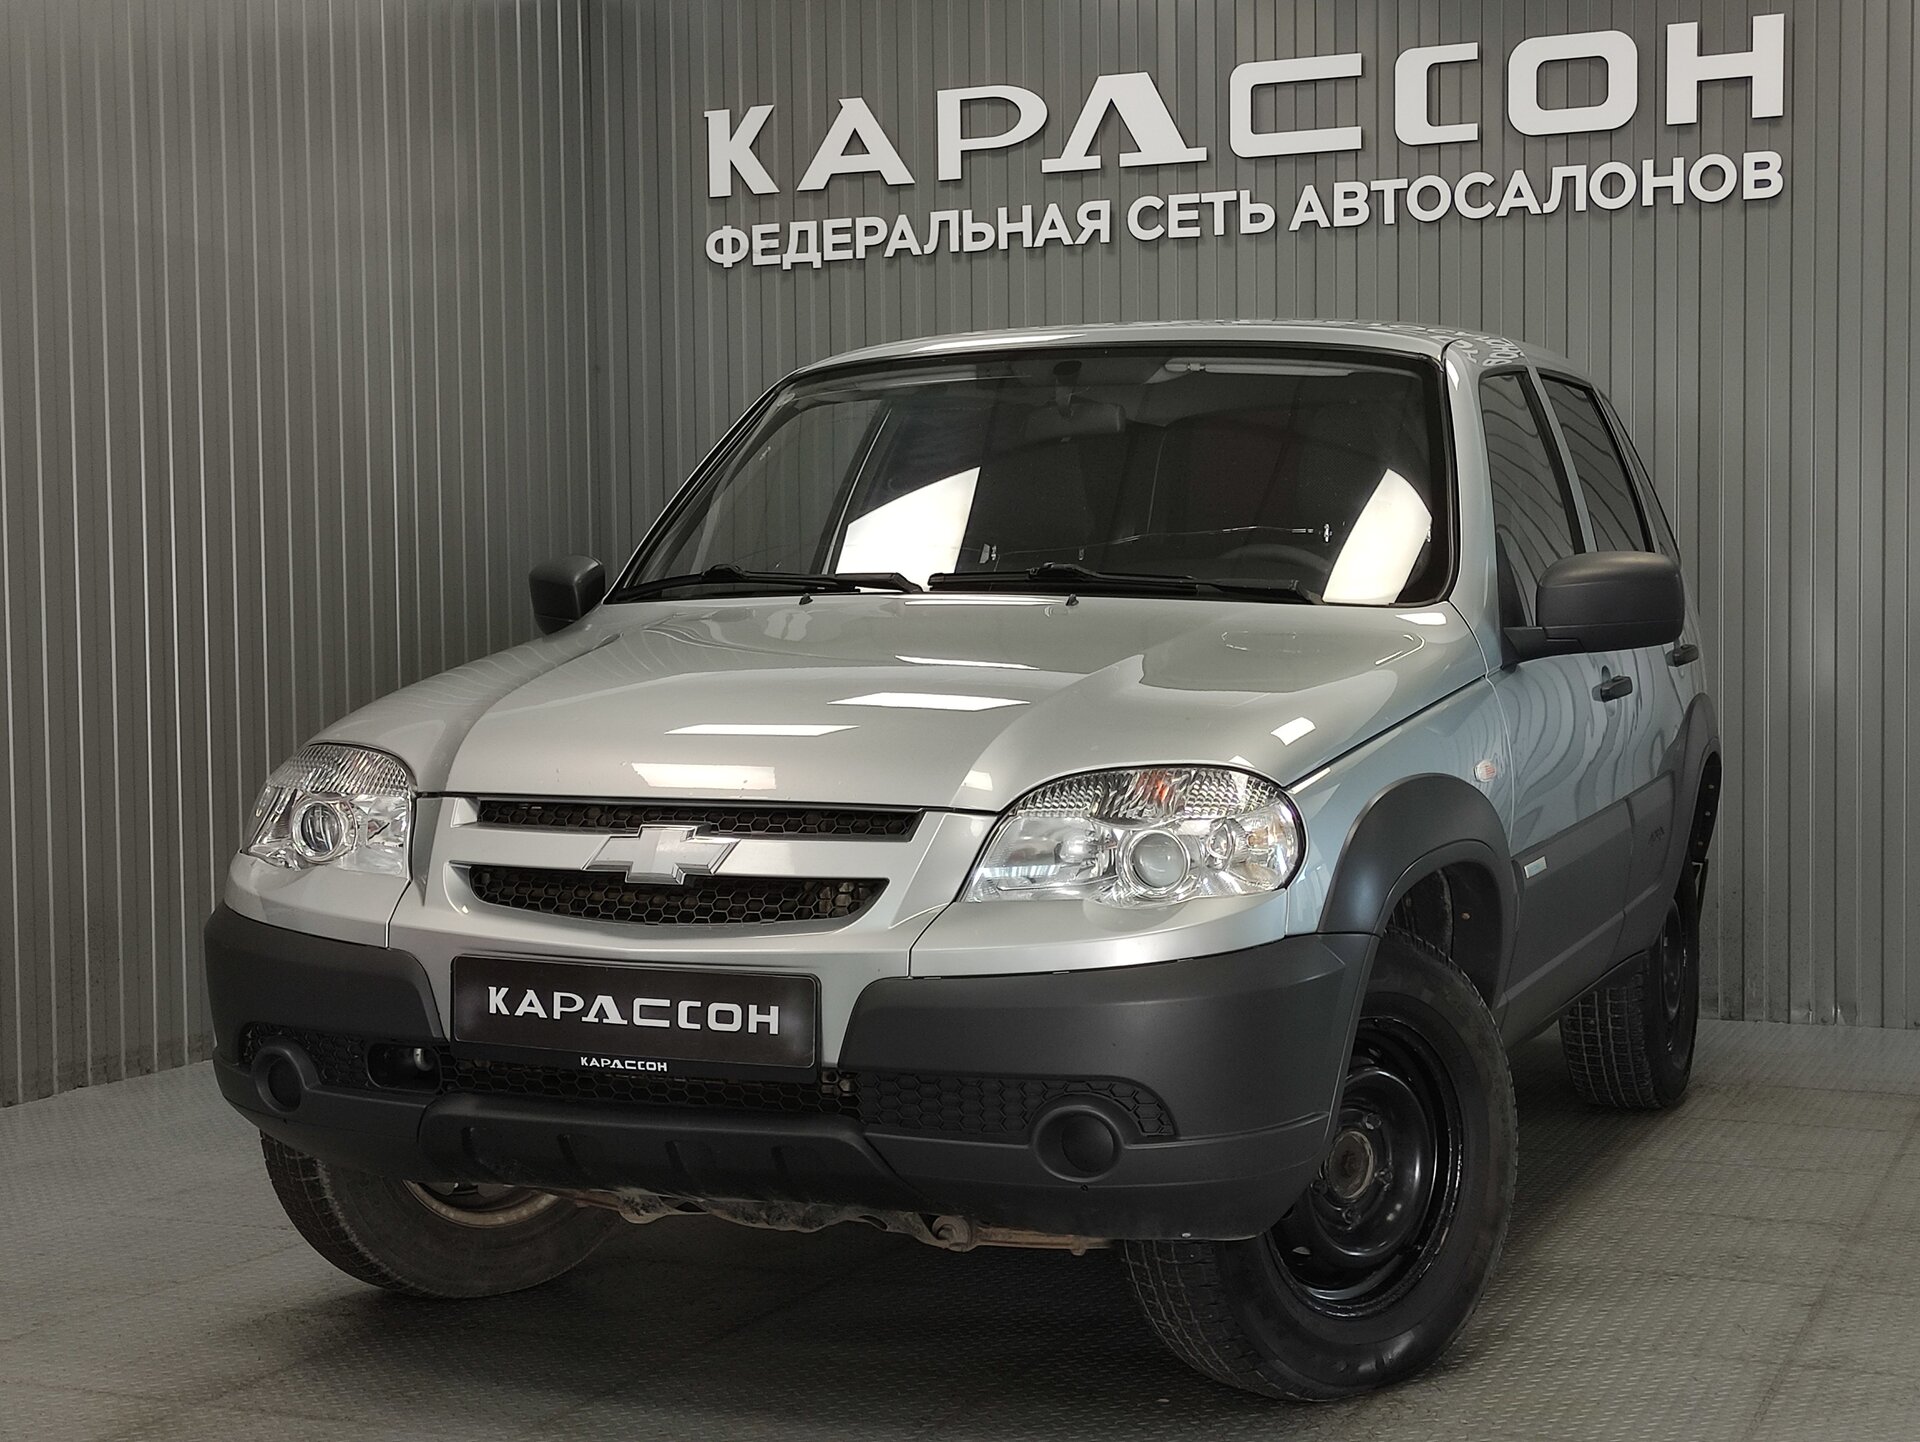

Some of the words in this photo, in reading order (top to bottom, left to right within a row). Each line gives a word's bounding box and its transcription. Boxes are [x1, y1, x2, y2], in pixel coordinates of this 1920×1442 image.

[705, 199, 1111, 270] ФЕДЕРАЛЬНАЯ
[1127, 189, 1276, 242] СЕТЬ
[1288, 150, 1784, 232] АВТОСАЛОНОВ
